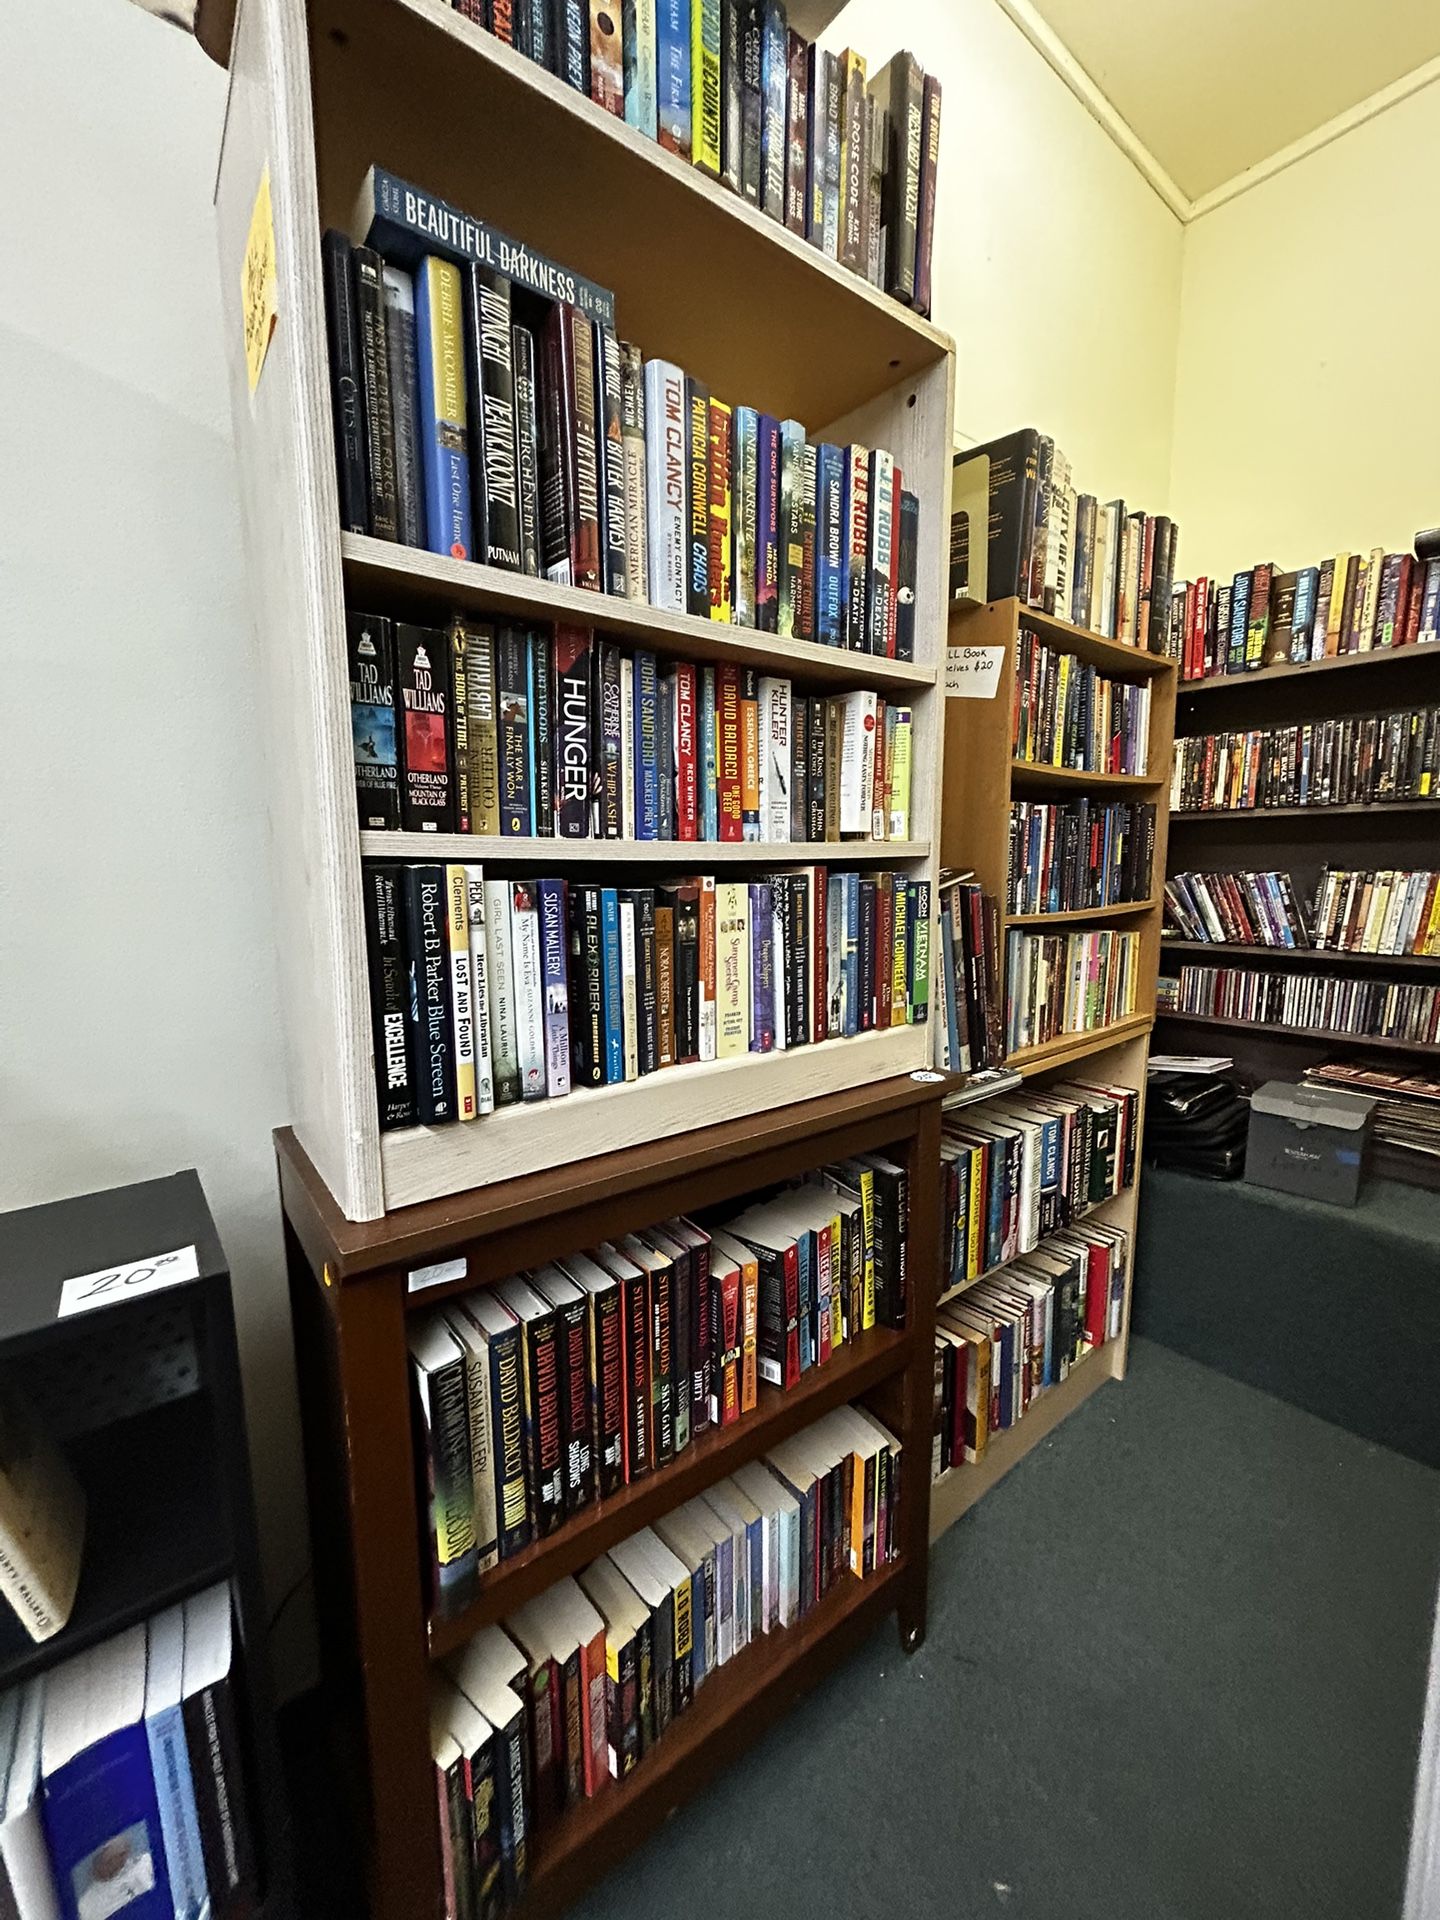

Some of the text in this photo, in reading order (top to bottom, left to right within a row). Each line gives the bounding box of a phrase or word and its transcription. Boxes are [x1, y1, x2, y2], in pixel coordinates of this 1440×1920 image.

[702, 69, 720, 153] COUNTRY
[828, 83, 838, 155] BRAD THOR
[851, 120, 860, 161] ROSE
[796, 190, 804, 222] STONE
[850, 164, 860, 208] CODE
[405, 191, 495, 265] BEAUTIFUL
[500, 241, 575, 305] DARKNESS
[440, 269, 458, 418] DEBBIE MACOMBER
[481, 285, 511, 371] MIDNIGHT
[604, 337, 621, 399] ANN RULE
[485, 395, 514, 436] DEAN
[624, 383, 635, 427] MICHAEL
[666, 378, 683, 512] TOM CLANCY
[450, 456, 464, 544] Last One Home
[487, 447, 516, 508] KOONTZ
[576, 432, 597, 522] BETRAYAL
[607, 441, 625, 553] BITTER HARVEST
[692, 396, 708, 595] PATRICIA CORNWELL CHAOS
[1042, 442, 1054, 525] VINCE FLYNN
[488, 546, 520, 564] PUTNAM
[674, 516, 682, 604] ENEMY CONTACT
[828, 480, 840, 618] SANDRA BROWN OUTFOX
[1056, 497, 1070, 601] CITY OF JOY
[1231, 576, 1248, 646] JOHN SANDFORD
[413, 669, 432, 690] TAD
[466, 635, 492, 721] LABYRINTH
[974, 661, 993, 672] $20
[1022, 680, 1030, 708] LIES
[402, 687, 444, 713] WILLIAMS
[603, 682, 612, 736] COULTER
[610, 684, 619, 738] CATHERINE
[680, 673, 691, 756] TOM CLANCY
[771, 690, 779, 740] KILLER
[779, 684, 788, 746] HUNTER
[506, 726, 515, 799] FINALLY WON
[515, 734, 523, 753] THE
[563, 678, 588, 801] HUNGER
[640, 658, 655, 828] JOHN SANDFORD MASKED PREY
[723, 684, 738, 780] DAVID BALDACCI
[746, 707, 755, 790] ESSENTIAL GREECE
[408, 772, 447, 785] OTHERLAND
[515, 757, 523, 780] WAR
[540, 760, 548, 810] SHAKEUP
[607, 760, 616, 825] WHIPLASH
[722, 792, 732, 812] DEED
[730, 785, 740, 819] ONE GOOD
[816, 809, 824, 831] JOHN
[452, 876, 465, 931] Clements
[469, 881, 483, 906] PECK
[920, 886, 929, 917] MOON
[476, 953, 485, 977] Here
[493, 899, 505, 990] GIRL LAST SEEN
[521, 918, 531, 985] My Name Is Eva
[543, 892, 560, 976] SUSAN MALLERY
[586, 915, 600, 1012] ALEX RIDER
[894, 891, 905, 992] MICHAEL CONNELLY
[918, 920, 928, 981] VIETNAM
[421, 882, 446, 1098] Robert B. Parker Blue Screen
[478, 979, 486, 999] Lies
[725, 956, 733, 991] Secrets
[729, 937, 741, 1007] Summer Camp
[456, 958, 471, 1057] LOST AND FOUND
[479, 1013, 489, 1058] Librarian
[499, 997, 509, 1058] NINA LAURIN
[384, 1012, 407, 1089] EXCELLENCE
[1046, 1124, 1057, 1180] TOM CLANCY
[820, 1254, 830, 1296] LEE CHILD
[658, 1275, 670, 1375] STUART WOODS
[745, 1284, 755, 1336] LEE CHILD
[536, 1341, 559, 1471] DAVID BALDACCI
[661, 1383, 670, 1448] SKIN GAME
[694, 1370, 703, 1402] DIRTY
[467, 1361, 487, 1476] SUSAN MALLERY
[499, 1356, 521, 1479] DAVID BALDACCI
[568, 1440, 581, 1488] SHADOWS
[579, 1444, 589, 1472] LONG
